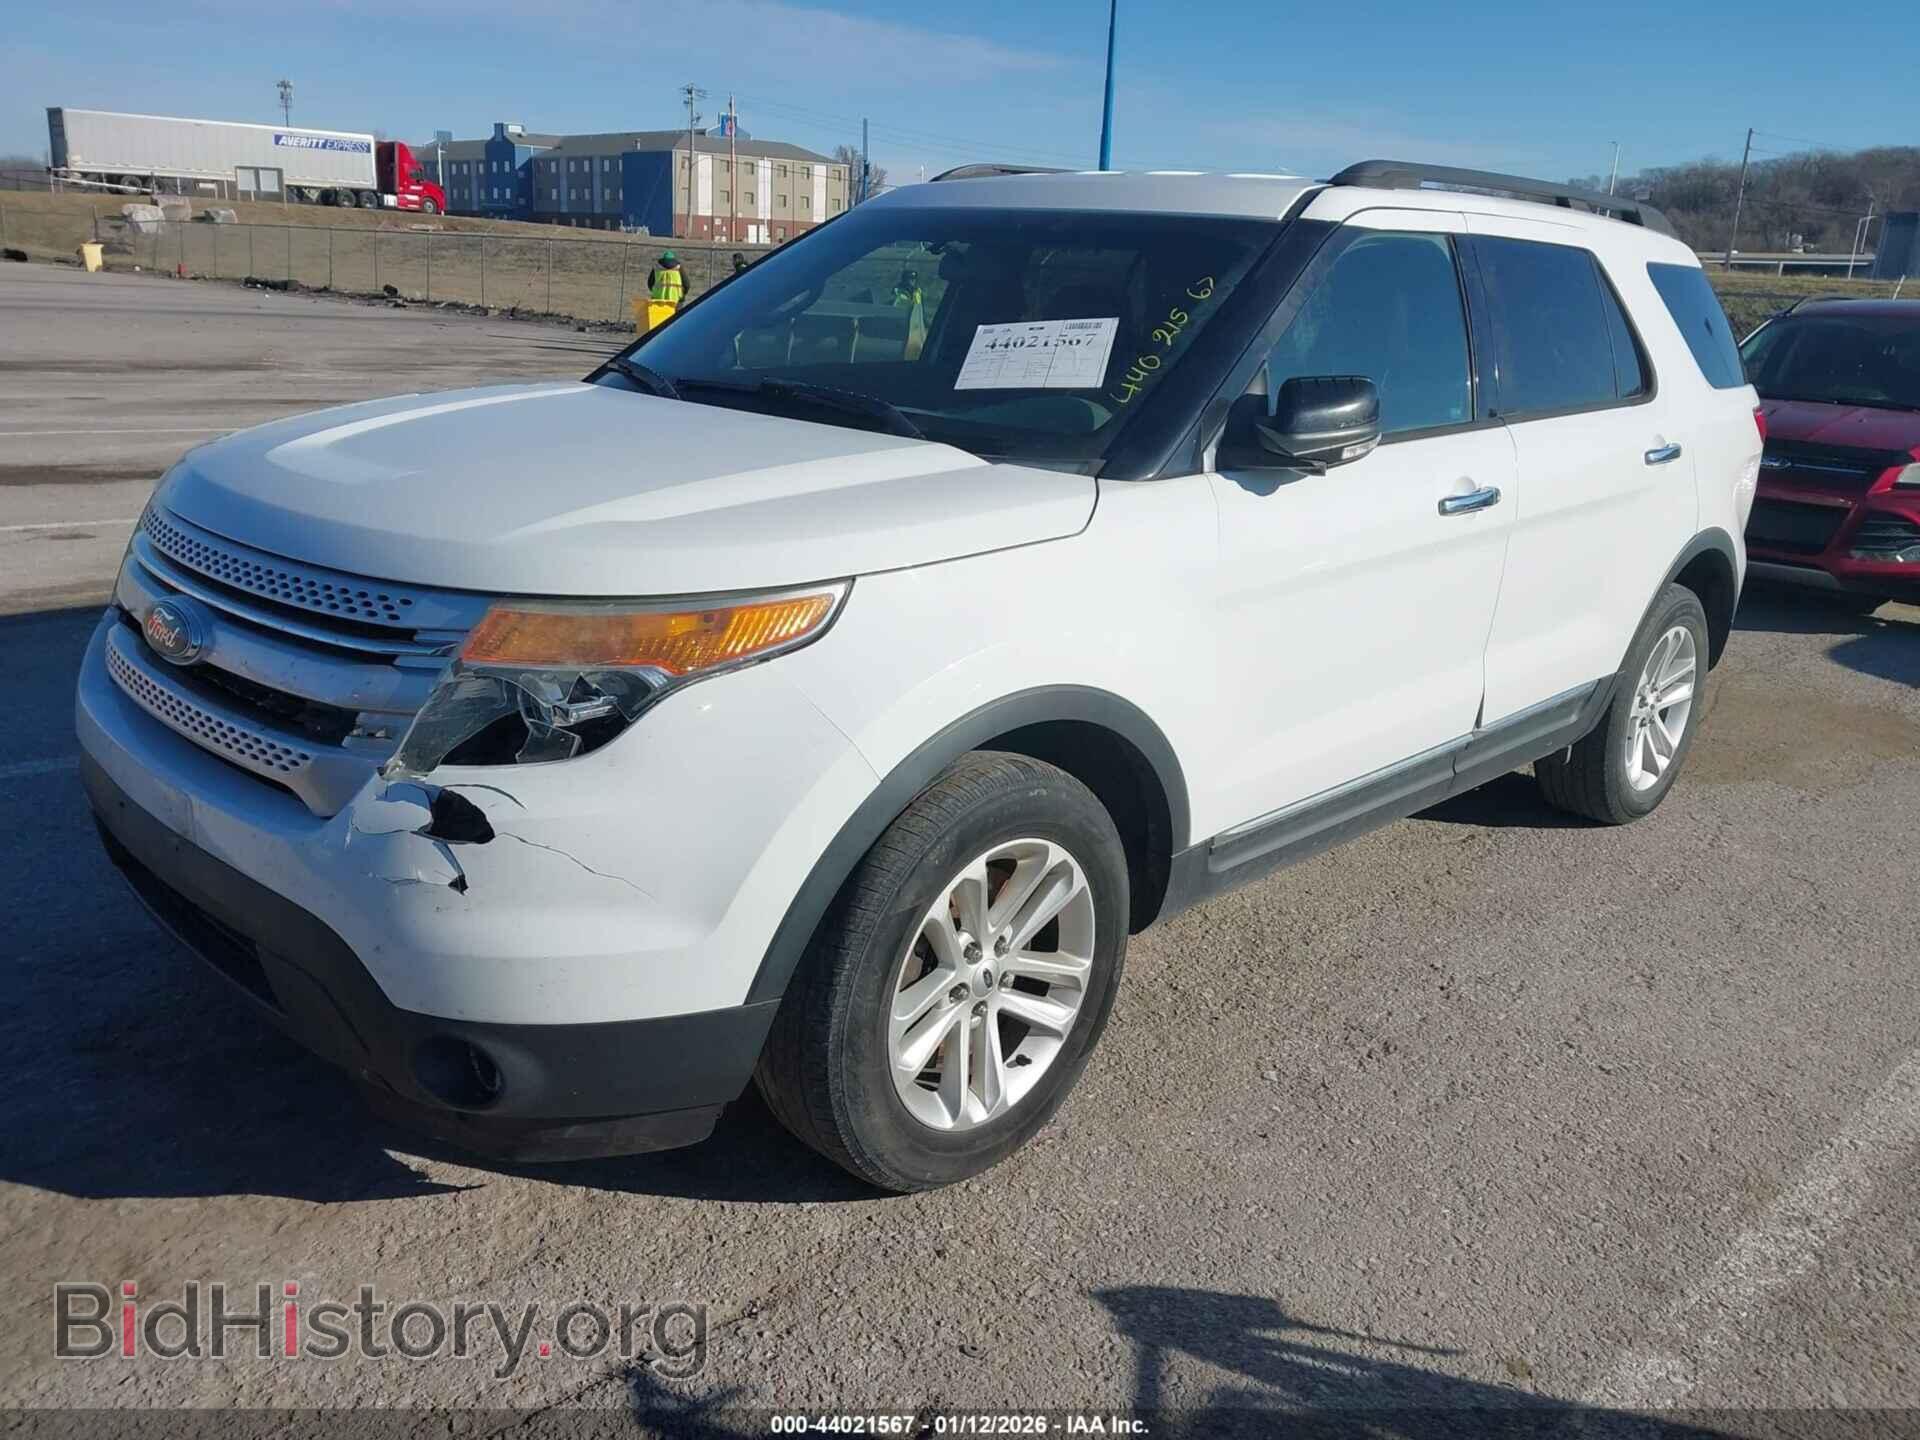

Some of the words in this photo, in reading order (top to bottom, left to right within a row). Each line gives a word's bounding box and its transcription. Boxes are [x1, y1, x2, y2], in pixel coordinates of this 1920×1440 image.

[279, 135, 325, 149] AVERITT
[326, 138, 369, 152] EXPRESS
[984, 333, 1097, 350] 44021567
[1109, 355, 1161, 403] 440
[1152, 307, 1188, 346] 215
[1186, 276, 1214, 299] 67
[147, 607, 180, 648] Ford
